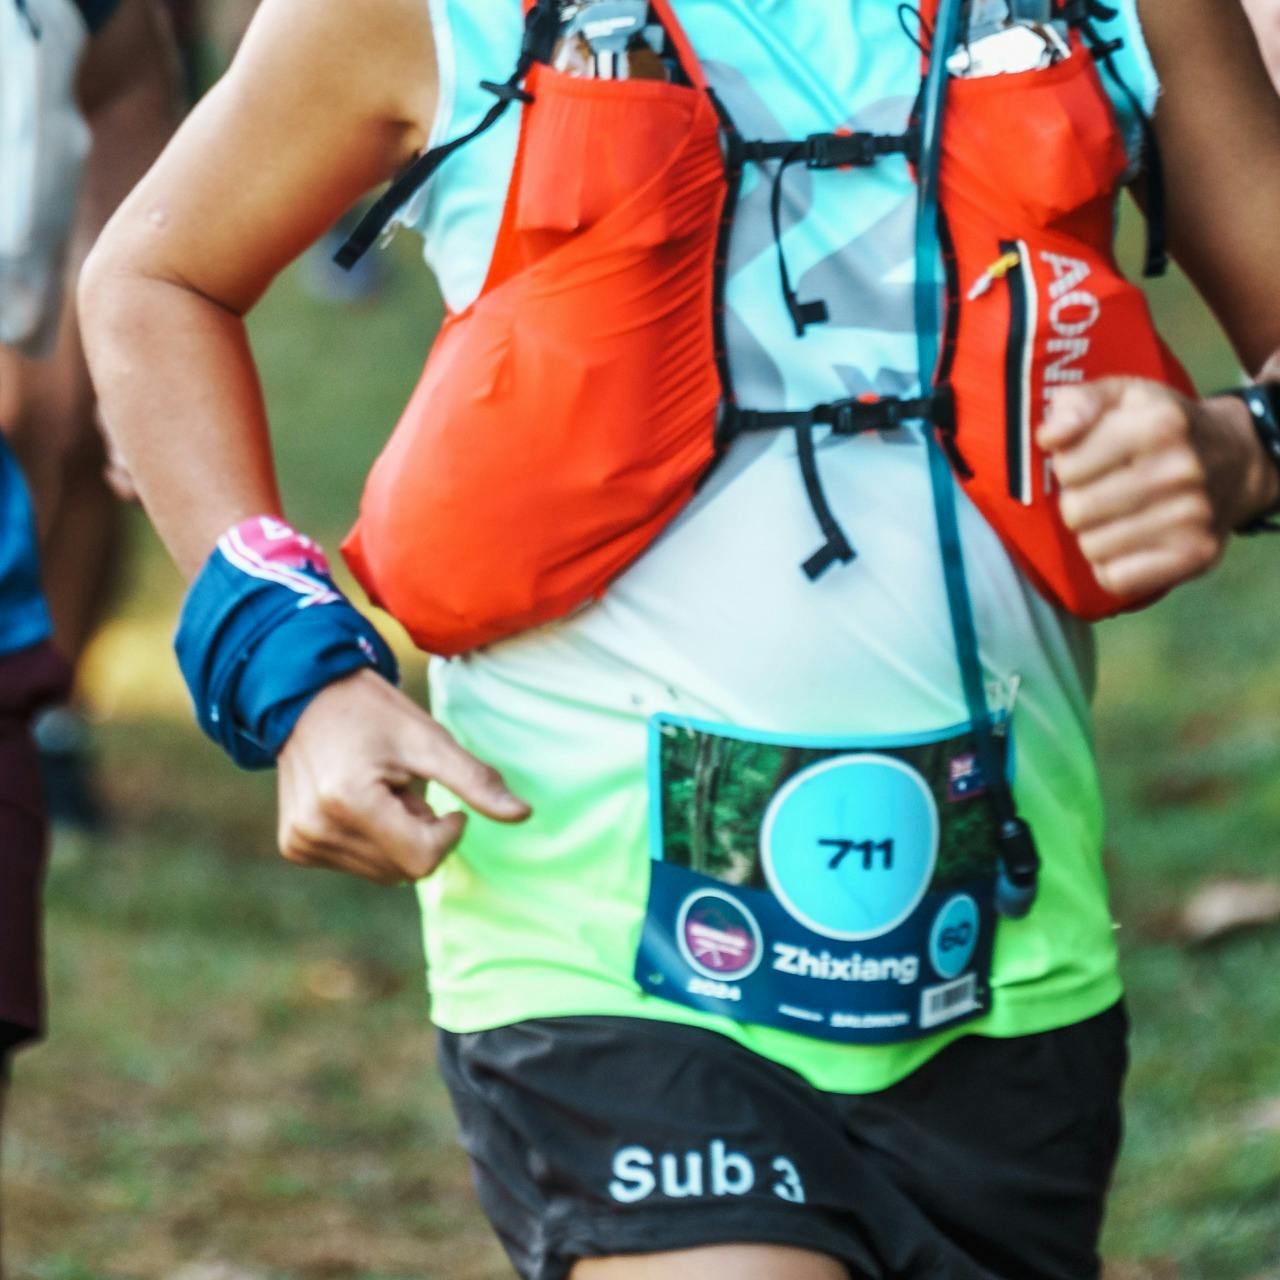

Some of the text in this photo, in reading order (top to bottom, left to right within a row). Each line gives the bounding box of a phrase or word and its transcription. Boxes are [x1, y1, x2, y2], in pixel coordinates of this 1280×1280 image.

[817, 837, 895, 871] 711
[772, 941, 919, 985] Zhixiang
[608, 1138, 756, 1204] Sub
